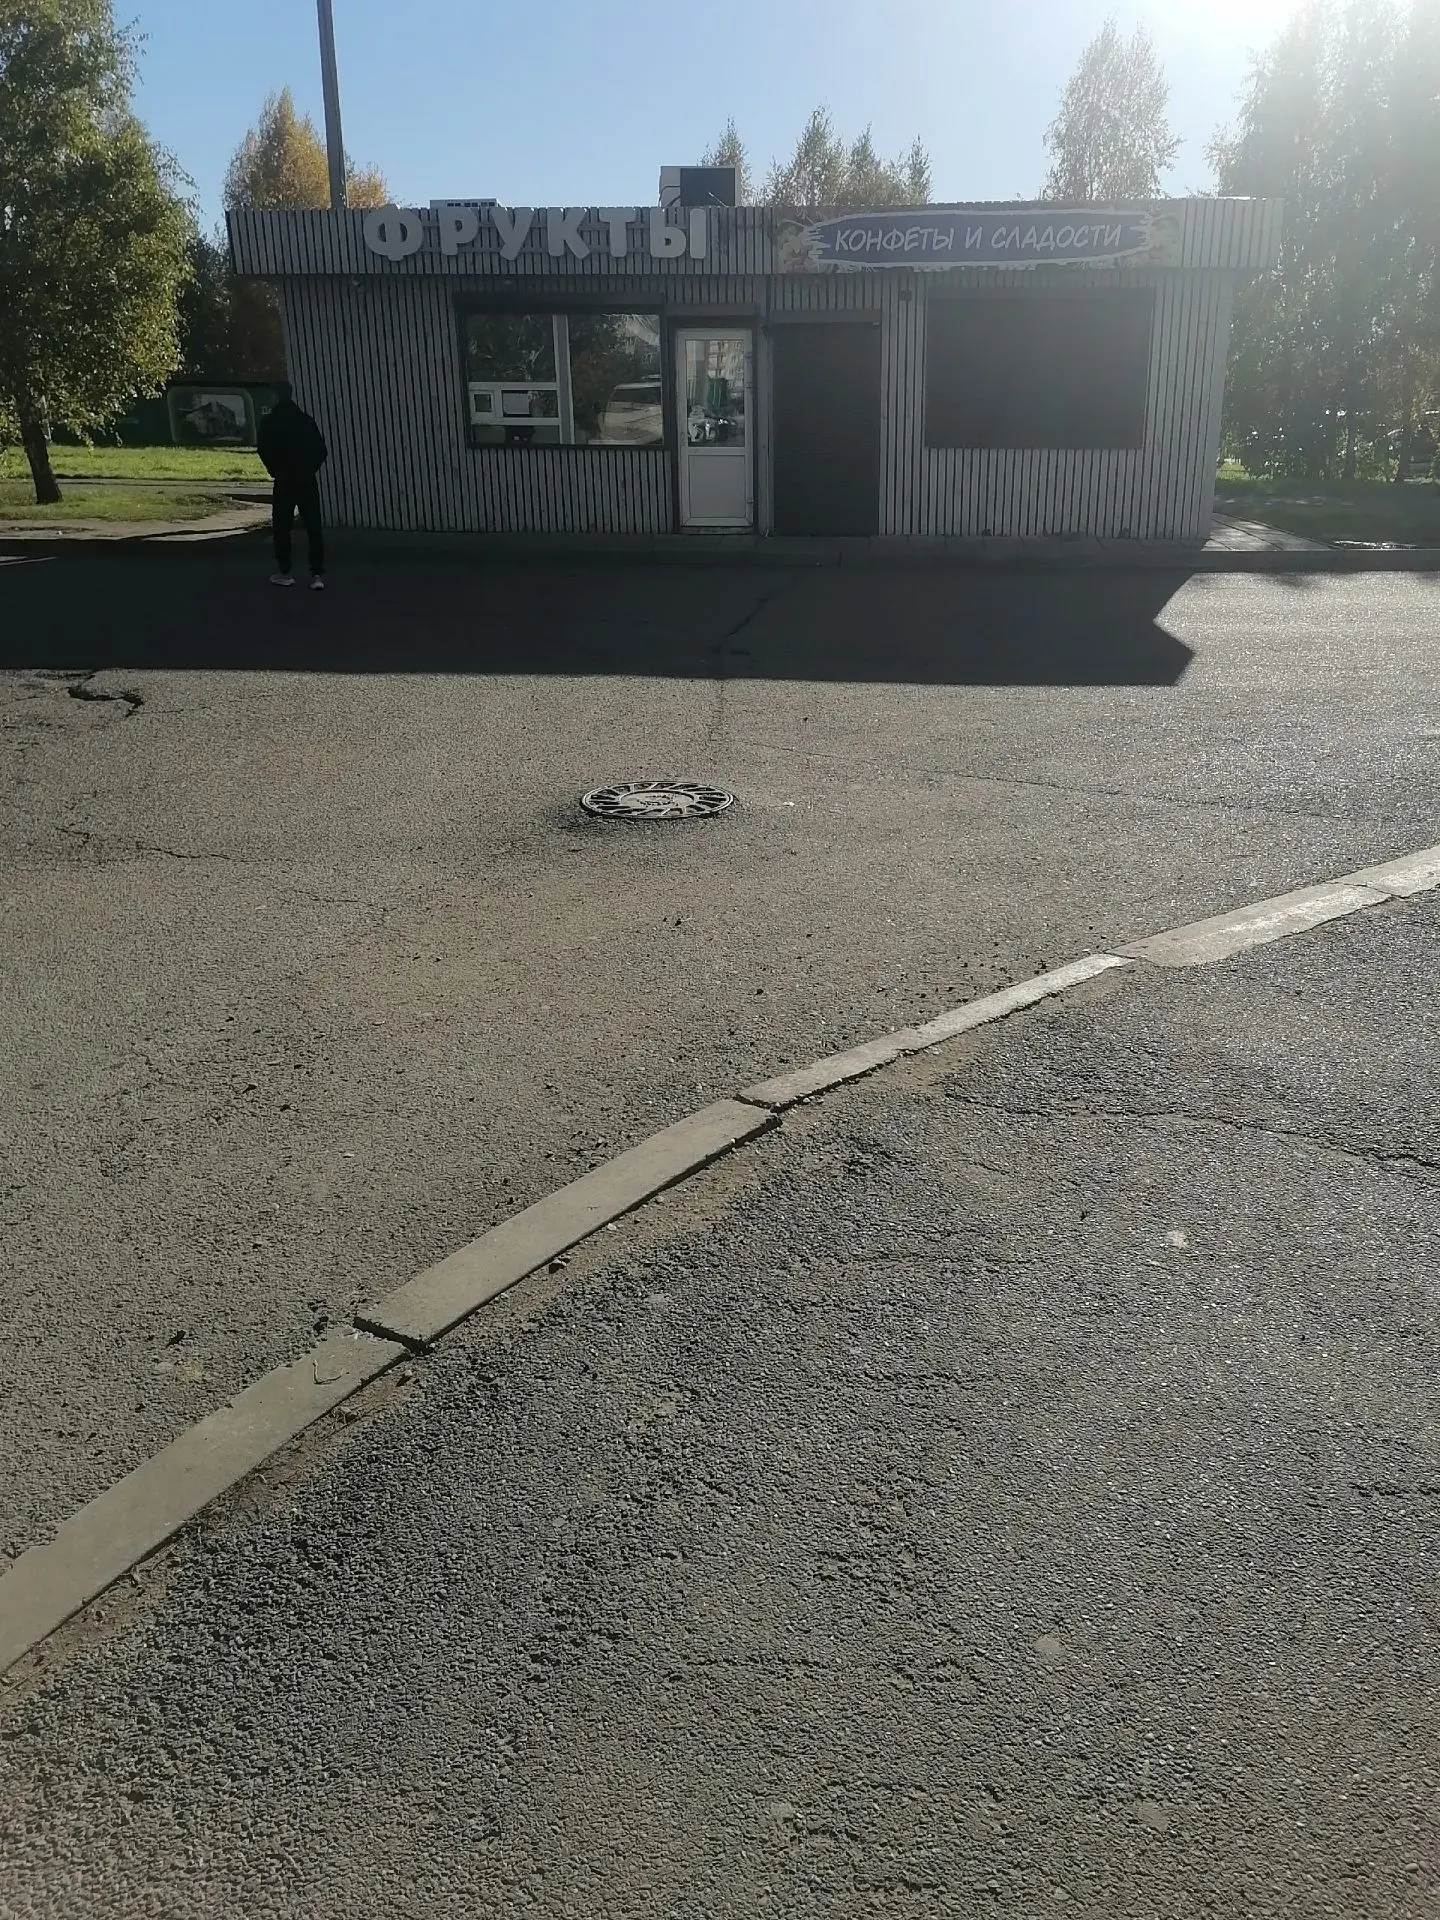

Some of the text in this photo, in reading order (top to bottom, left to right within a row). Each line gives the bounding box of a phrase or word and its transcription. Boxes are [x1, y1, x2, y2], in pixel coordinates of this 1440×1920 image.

[363, 203, 707, 261] ФРУКТЫ
[835, 224, 1122, 252] КОНФЕТЫ И СЛАДОСТИ
